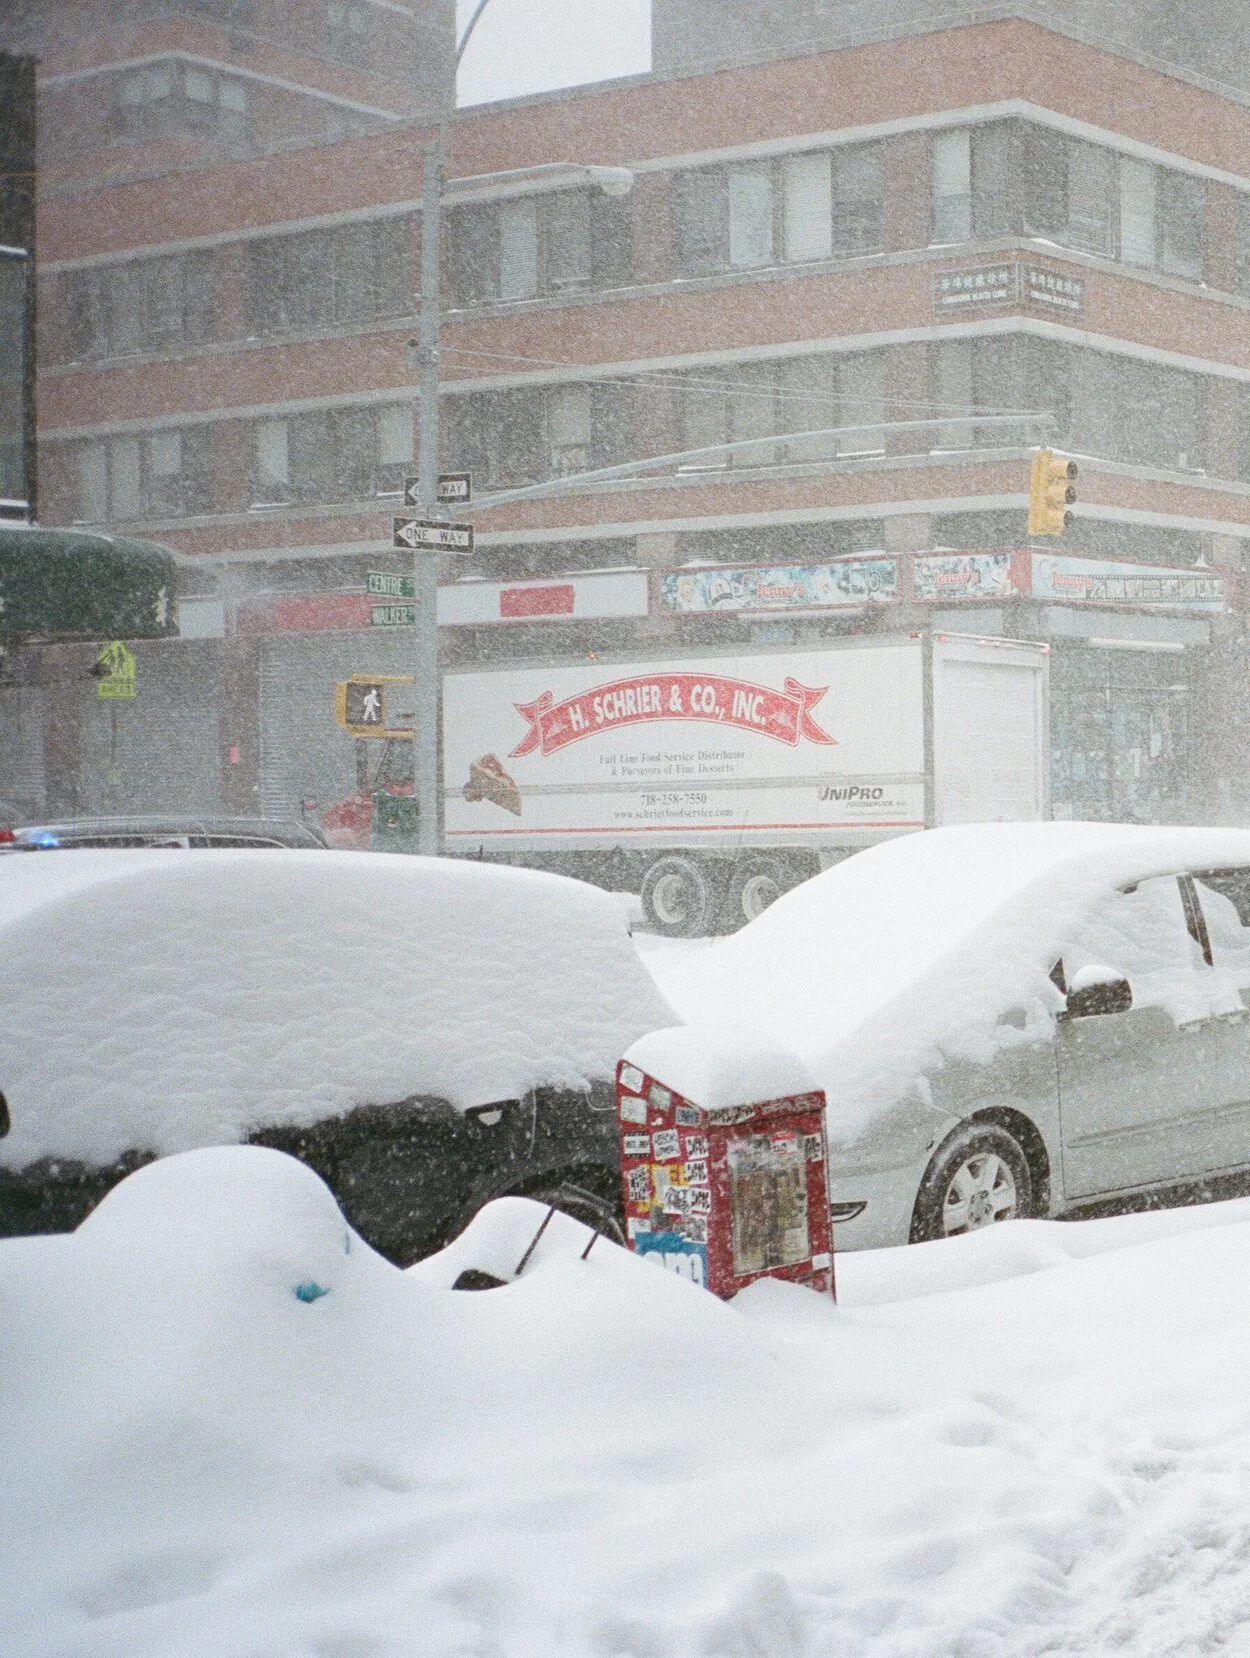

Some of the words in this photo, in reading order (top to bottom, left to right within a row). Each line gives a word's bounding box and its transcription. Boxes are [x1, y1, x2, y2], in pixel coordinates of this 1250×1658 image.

[442, 483, 464, 495] WAY
[405, 527, 429, 542] ONE
[440, 530, 463, 544] WAY
[369, 574, 404, 596] CENTRE
[372, 606, 407, 625] WALKER
[568, 706, 590, 732] H.
[593, 685, 662, 723] SCHRIER
[668, 684, 683, 712] &
[691, 684, 725, 719] CO.,
[732, 689, 767, 724] INC.
[600, 754, 616, 764] Full
[620, 753, 639, 764] Line
[641, 752, 661, 763] Food
[664, 751, 695, 762] Service
[697, 750, 745, 761] Distributor
[621, 765, 662, 777] Purveyors
[664, 764, 673, 774] of
[676, 764, 695, 774] Fine
[698, 763, 735, 774] Desserts
[640, 793, 707, 806] 718-258-7550
[614, 808, 733, 821] www.schrierfoodservice.com
